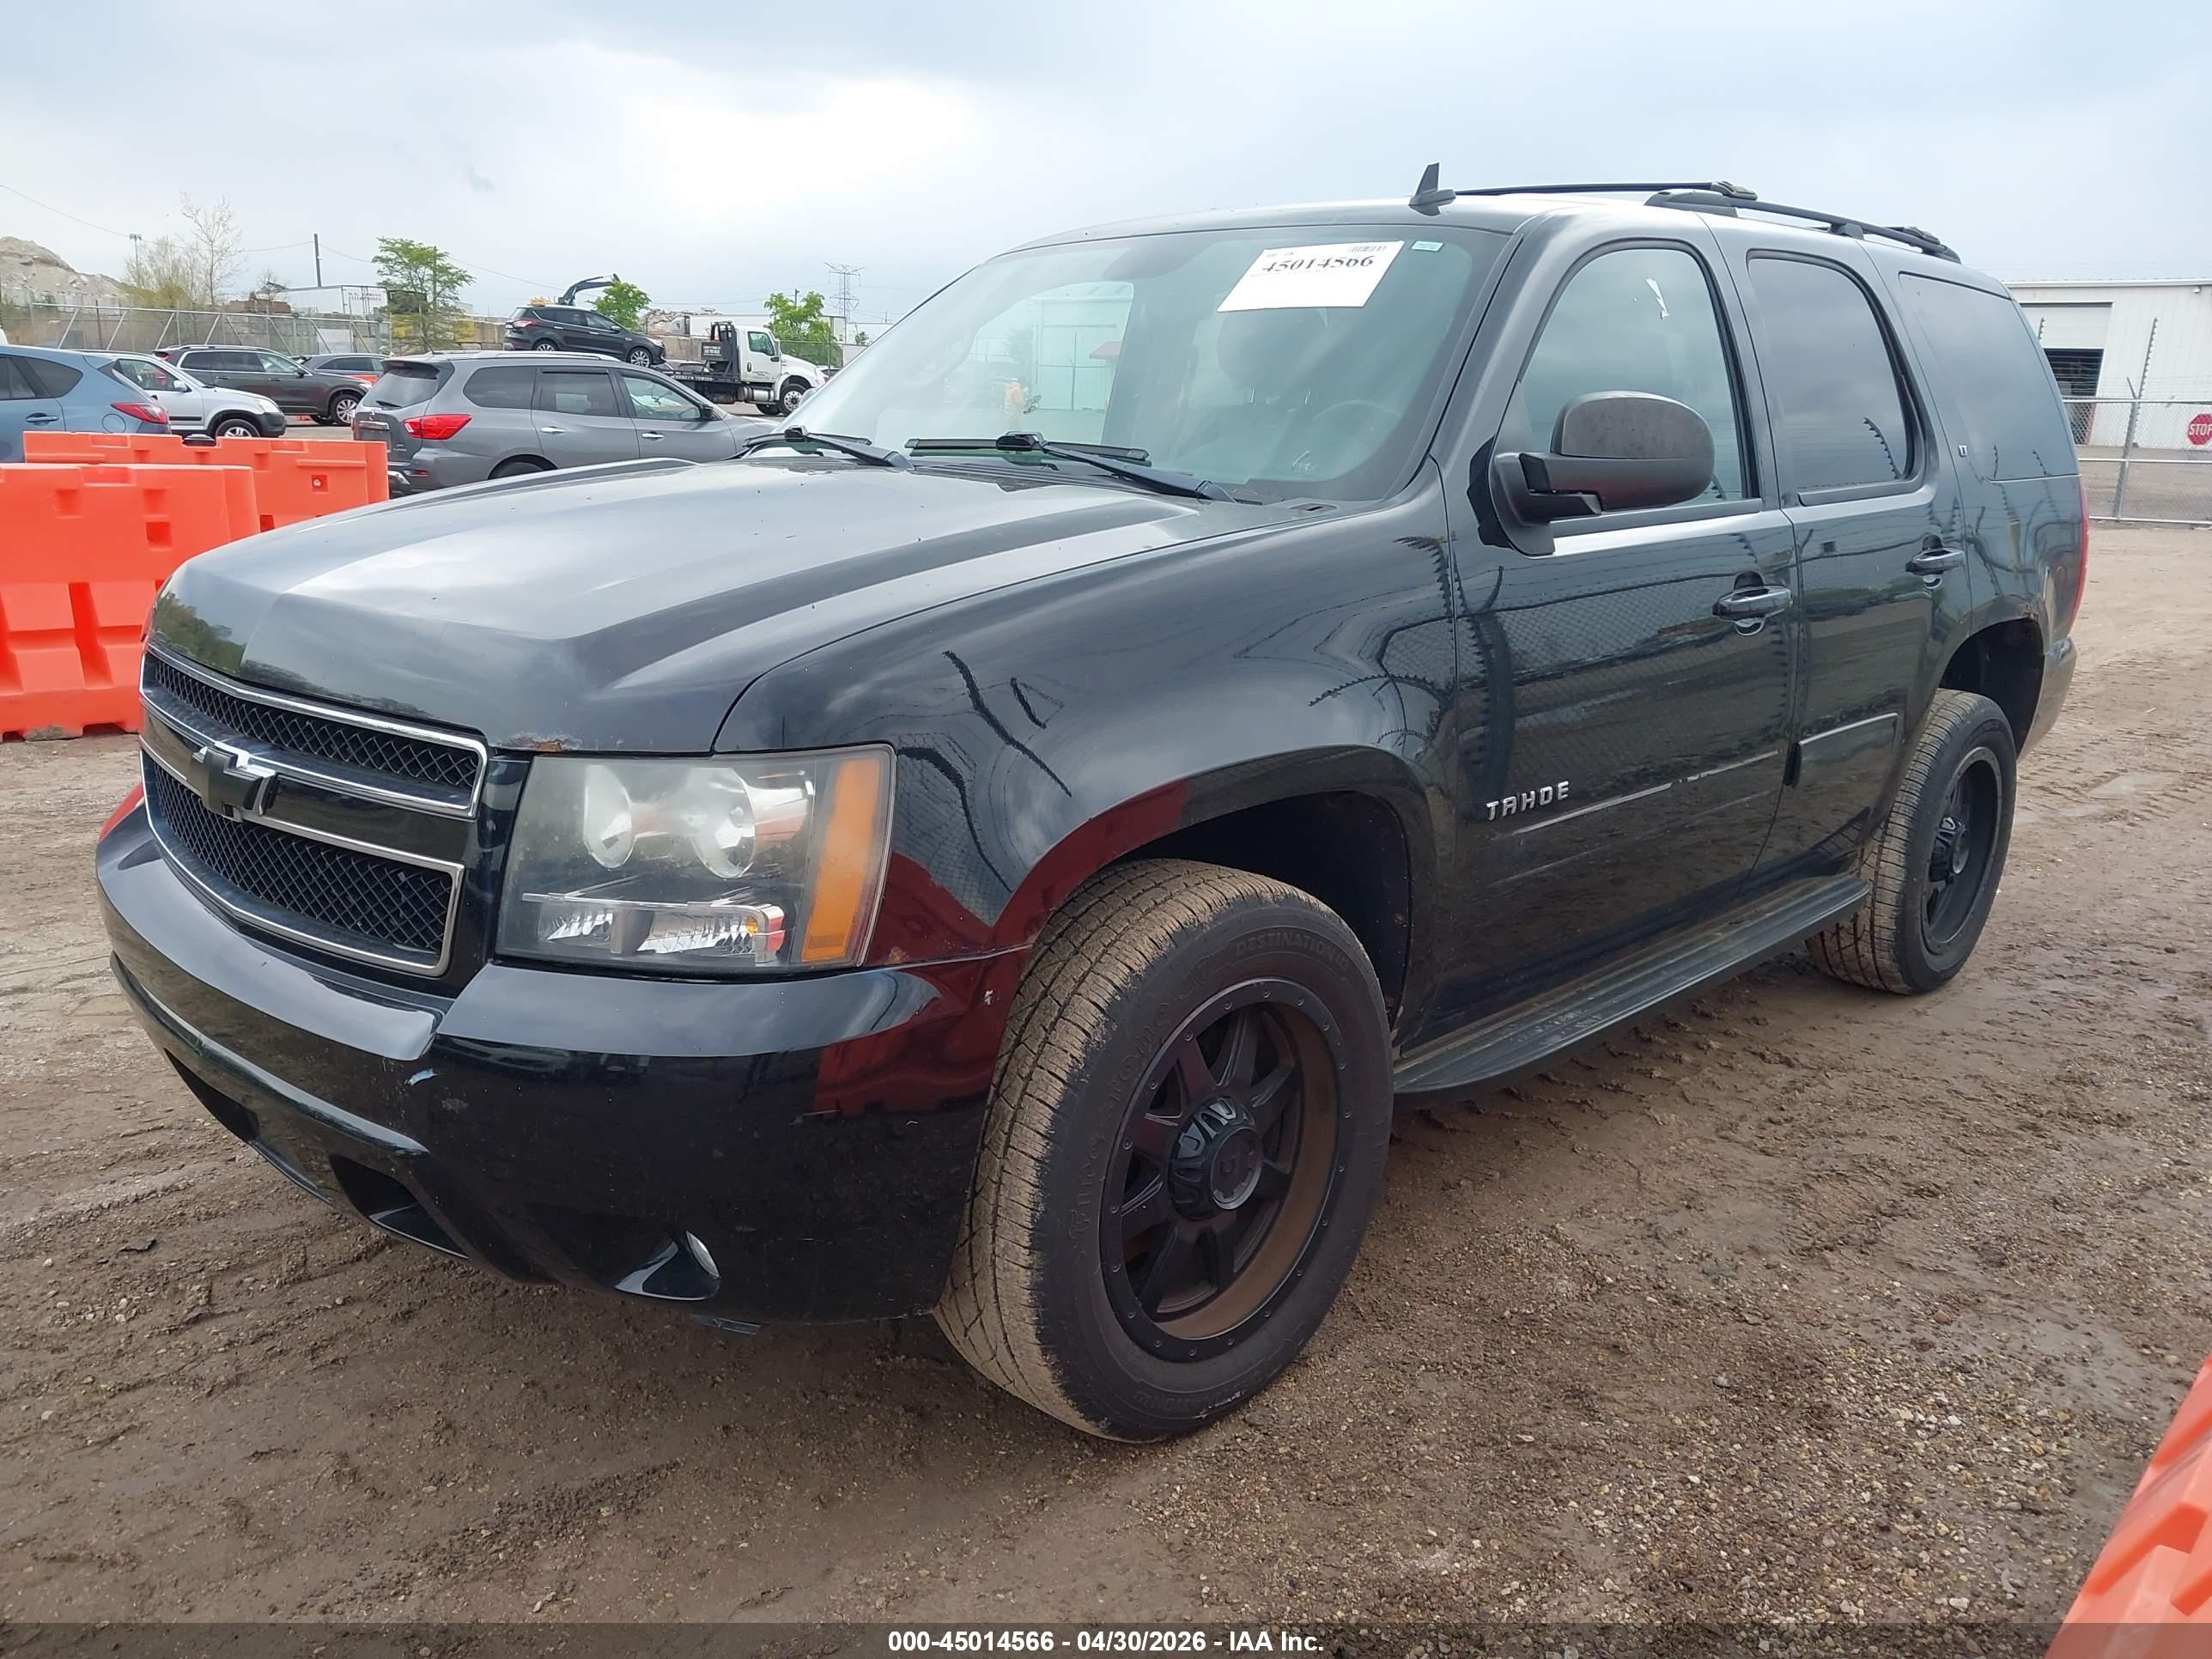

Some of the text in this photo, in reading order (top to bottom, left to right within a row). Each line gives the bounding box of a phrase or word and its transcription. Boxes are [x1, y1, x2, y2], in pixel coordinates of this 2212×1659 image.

[1263, 255, 1376, 272] 45014566
[2189, 423, 2212, 435] STOP
[1486, 781, 1570, 821] TAHOE
[1236, 930, 1337, 960] DESTINATION
